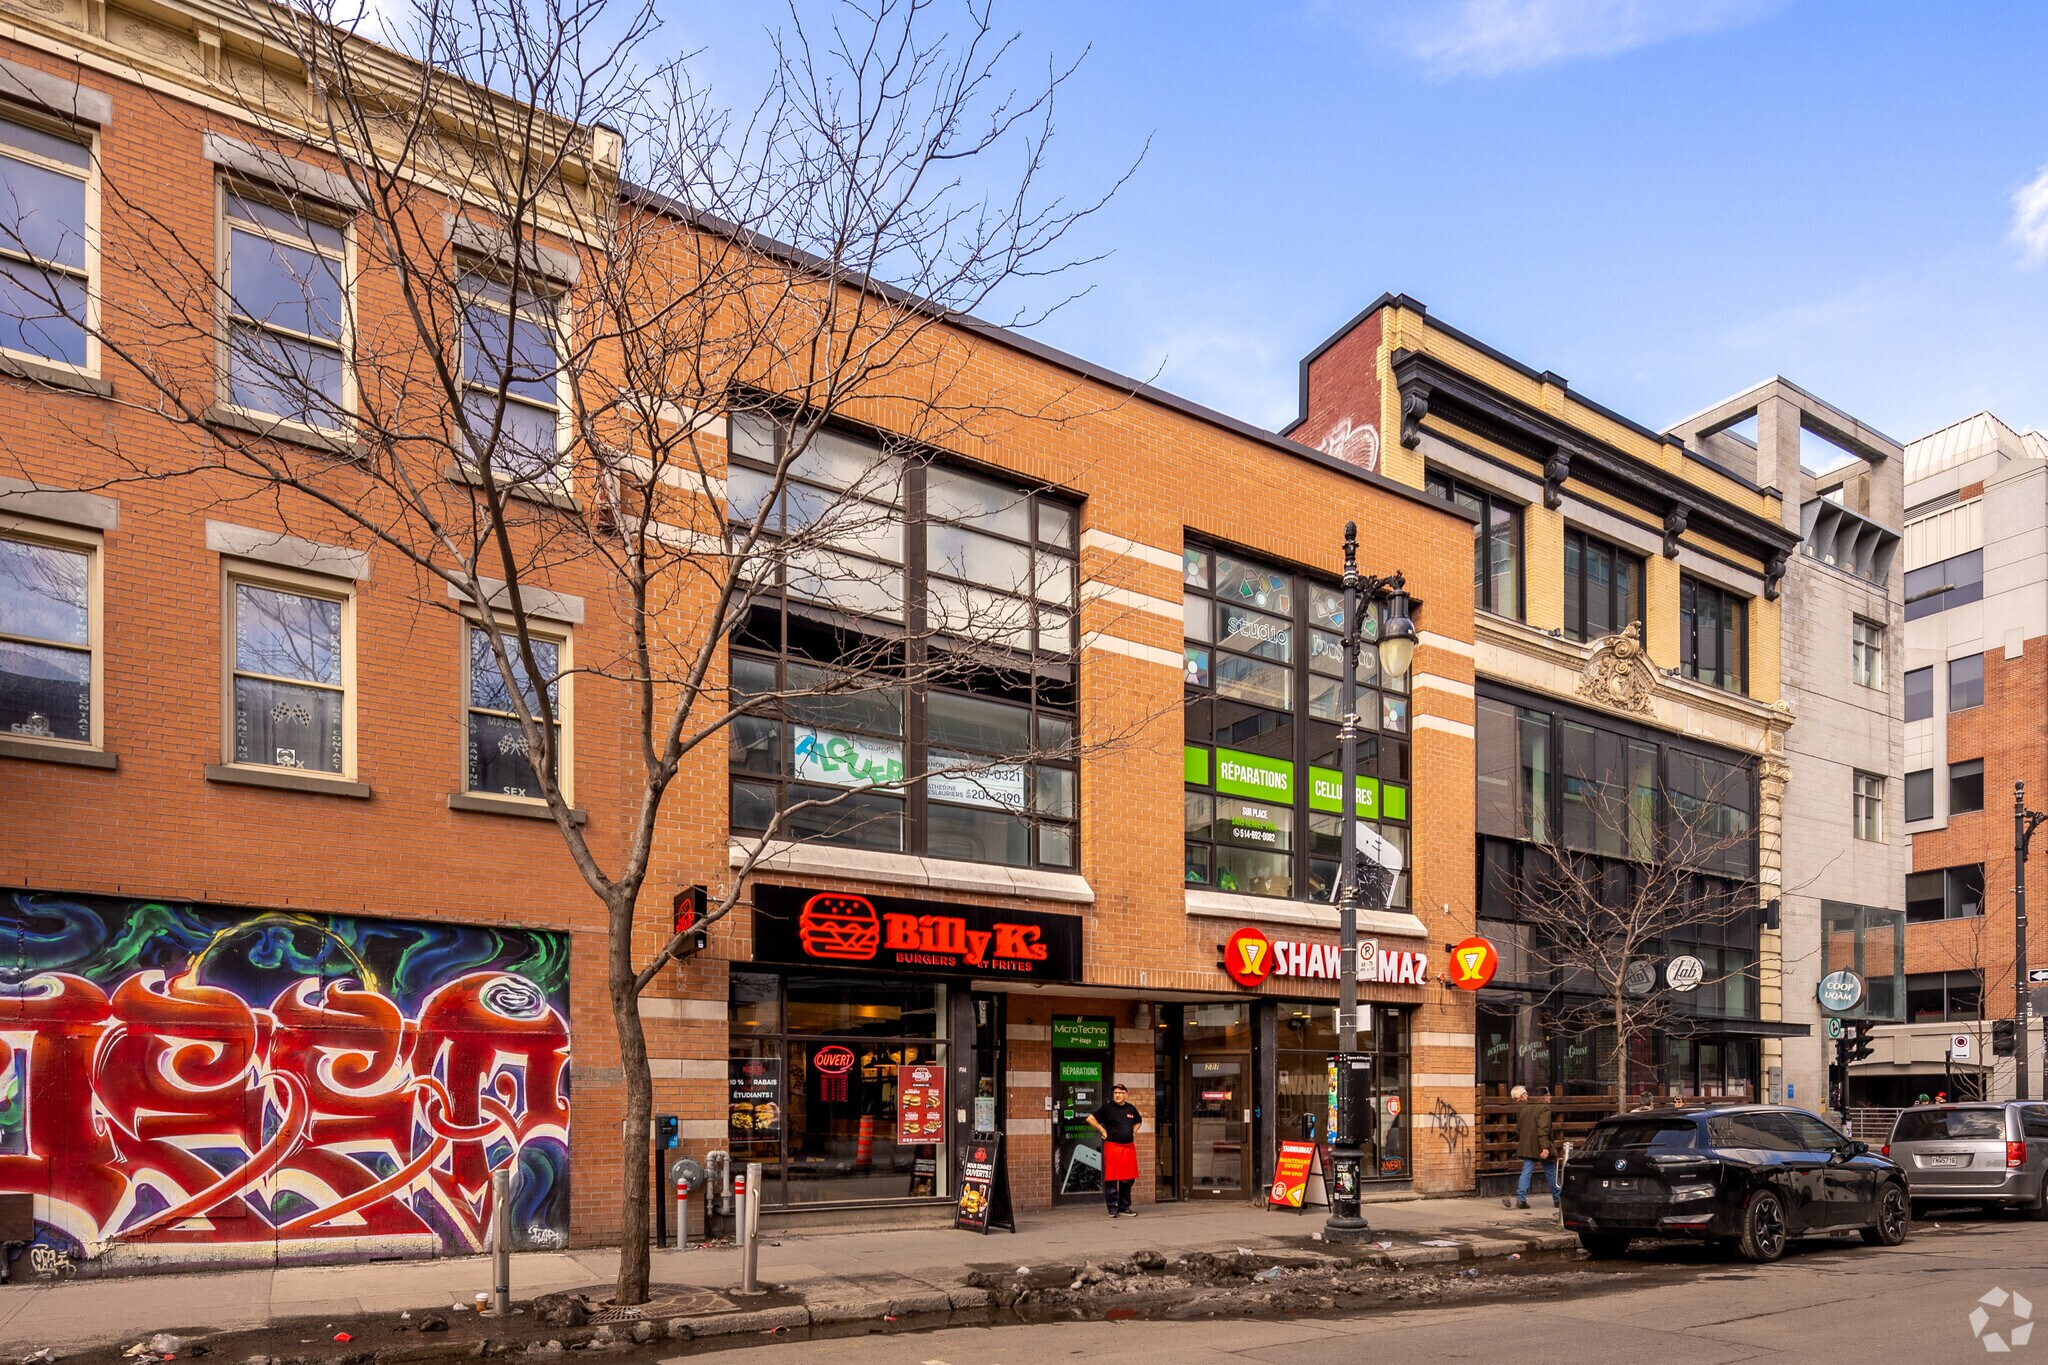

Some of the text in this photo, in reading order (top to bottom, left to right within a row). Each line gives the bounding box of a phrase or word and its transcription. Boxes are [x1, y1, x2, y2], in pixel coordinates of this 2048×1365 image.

[275, 593, 303, 606] SEX
[1228, 617, 1287, 646] studio
[11, 723, 43, 736] SEX
[487, 717, 544, 734] MASSE
[237, 711, 248, 760] DANCING
[332, 730, 342, 770] CONTACT
[469, 742, 478, 787] DANCING
[927, 784, 957, 792] ATHERINE
[1221, 761, 1373, 806] RÉPARATIONS CELLURES
[503, 786, 527, 797] SEX
[1242, 806, 1268, 820] SUR PLACE
[883, 912, 1048, 965] Billy K's
[896, 952, 957, 967] BURGERS
[977, 959, 1033, 972] ET FRITES
[1273, 940, 1428, 985] SHAWMAZ
[1673, 959, 1697, 980] Lab
[1827, 982, 1854, 992] COOP
[1054, 1024, 1107, 1035] MicroTechno
[816, 1054, 851, 1067] OUVERT
[1062, 1065, 1098, 1076] RÉPARATIONS
[733, 1090, 770, 1099] ÉTUDIANTS
